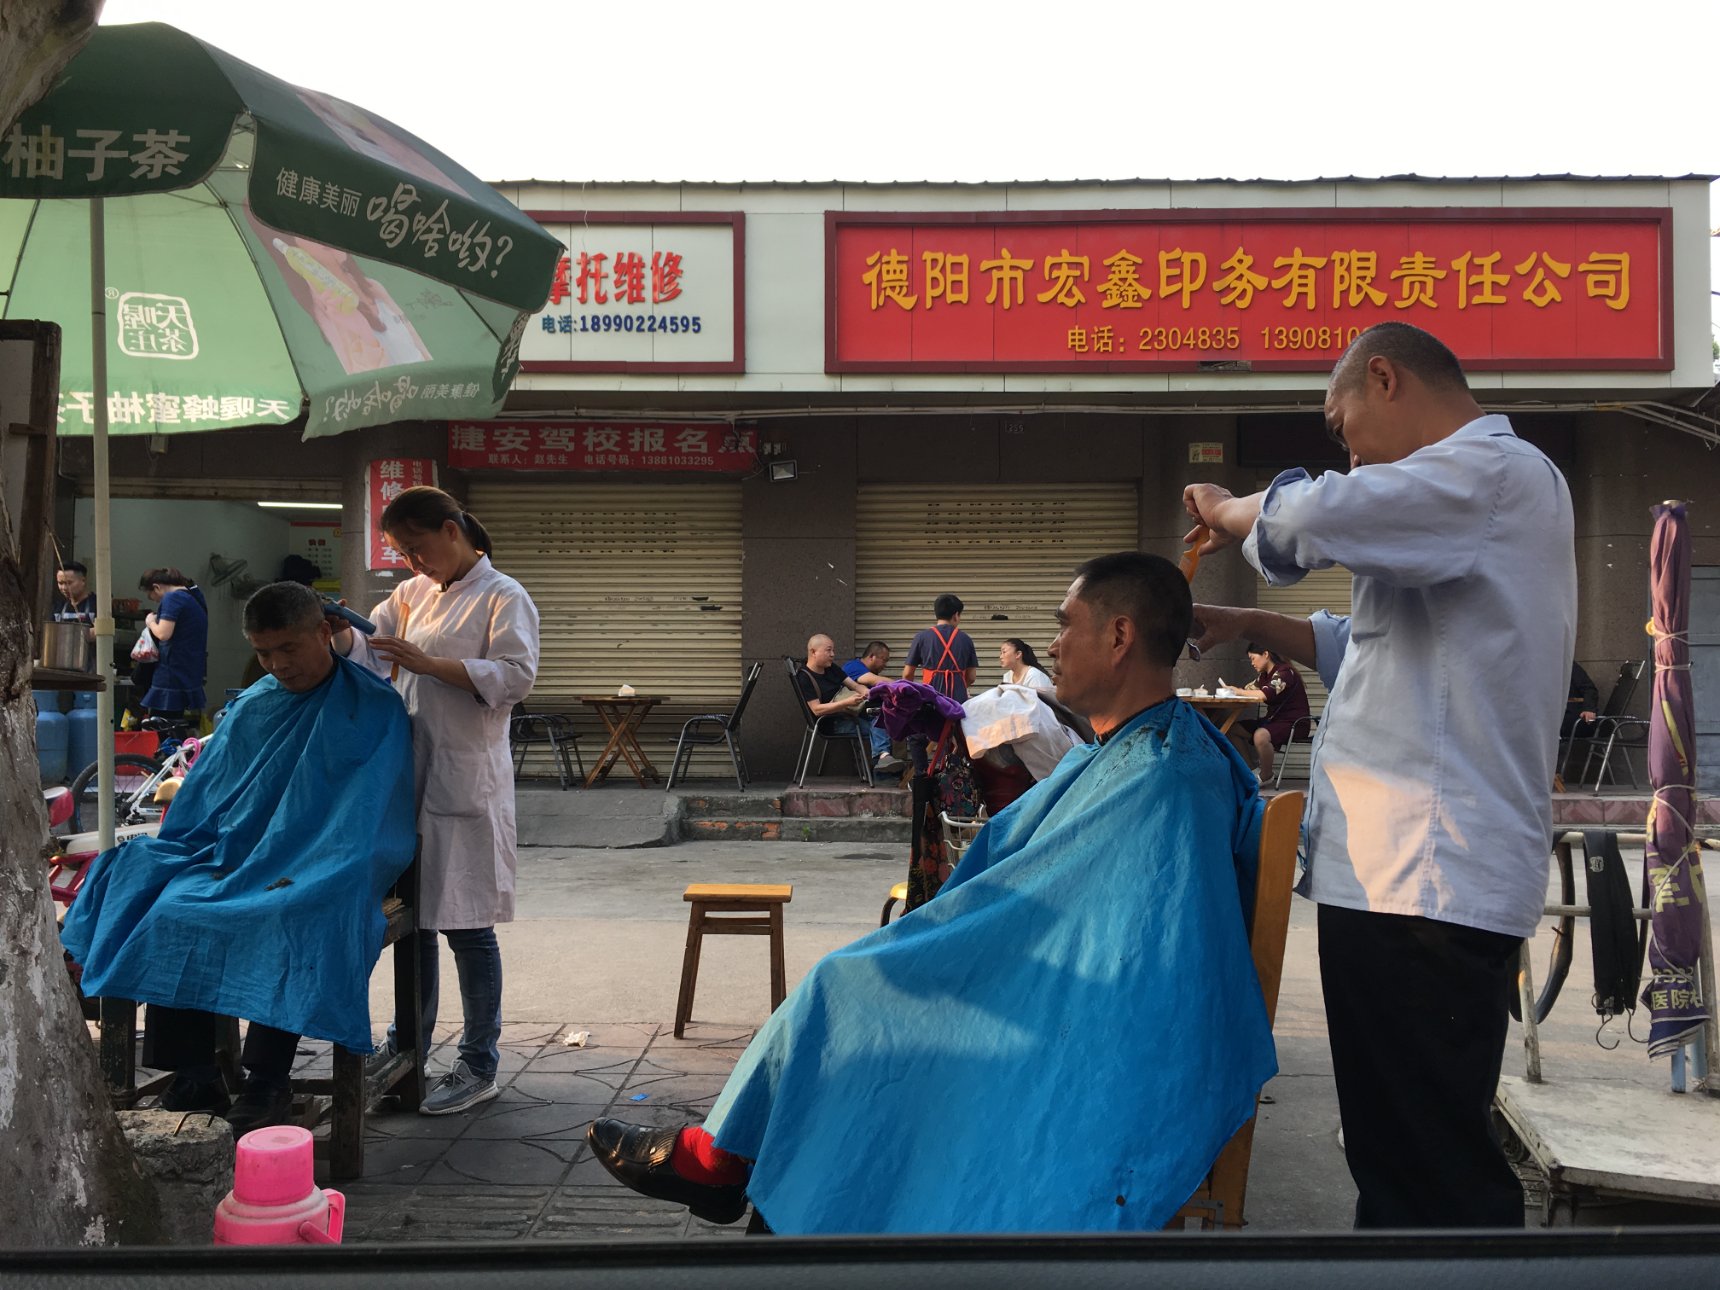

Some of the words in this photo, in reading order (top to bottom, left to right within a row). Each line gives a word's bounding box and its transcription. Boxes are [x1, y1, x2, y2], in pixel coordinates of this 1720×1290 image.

[1, 122, 191, 182] 柚子茶
[276, 167, 363, 218] 健康美丽
[861, 246, 1632, 311] 德阳市宏鑫印务有限责任公司
[1260, 326, 1371, 350] 1390810
[380, 460, 405, 564] 维修车
